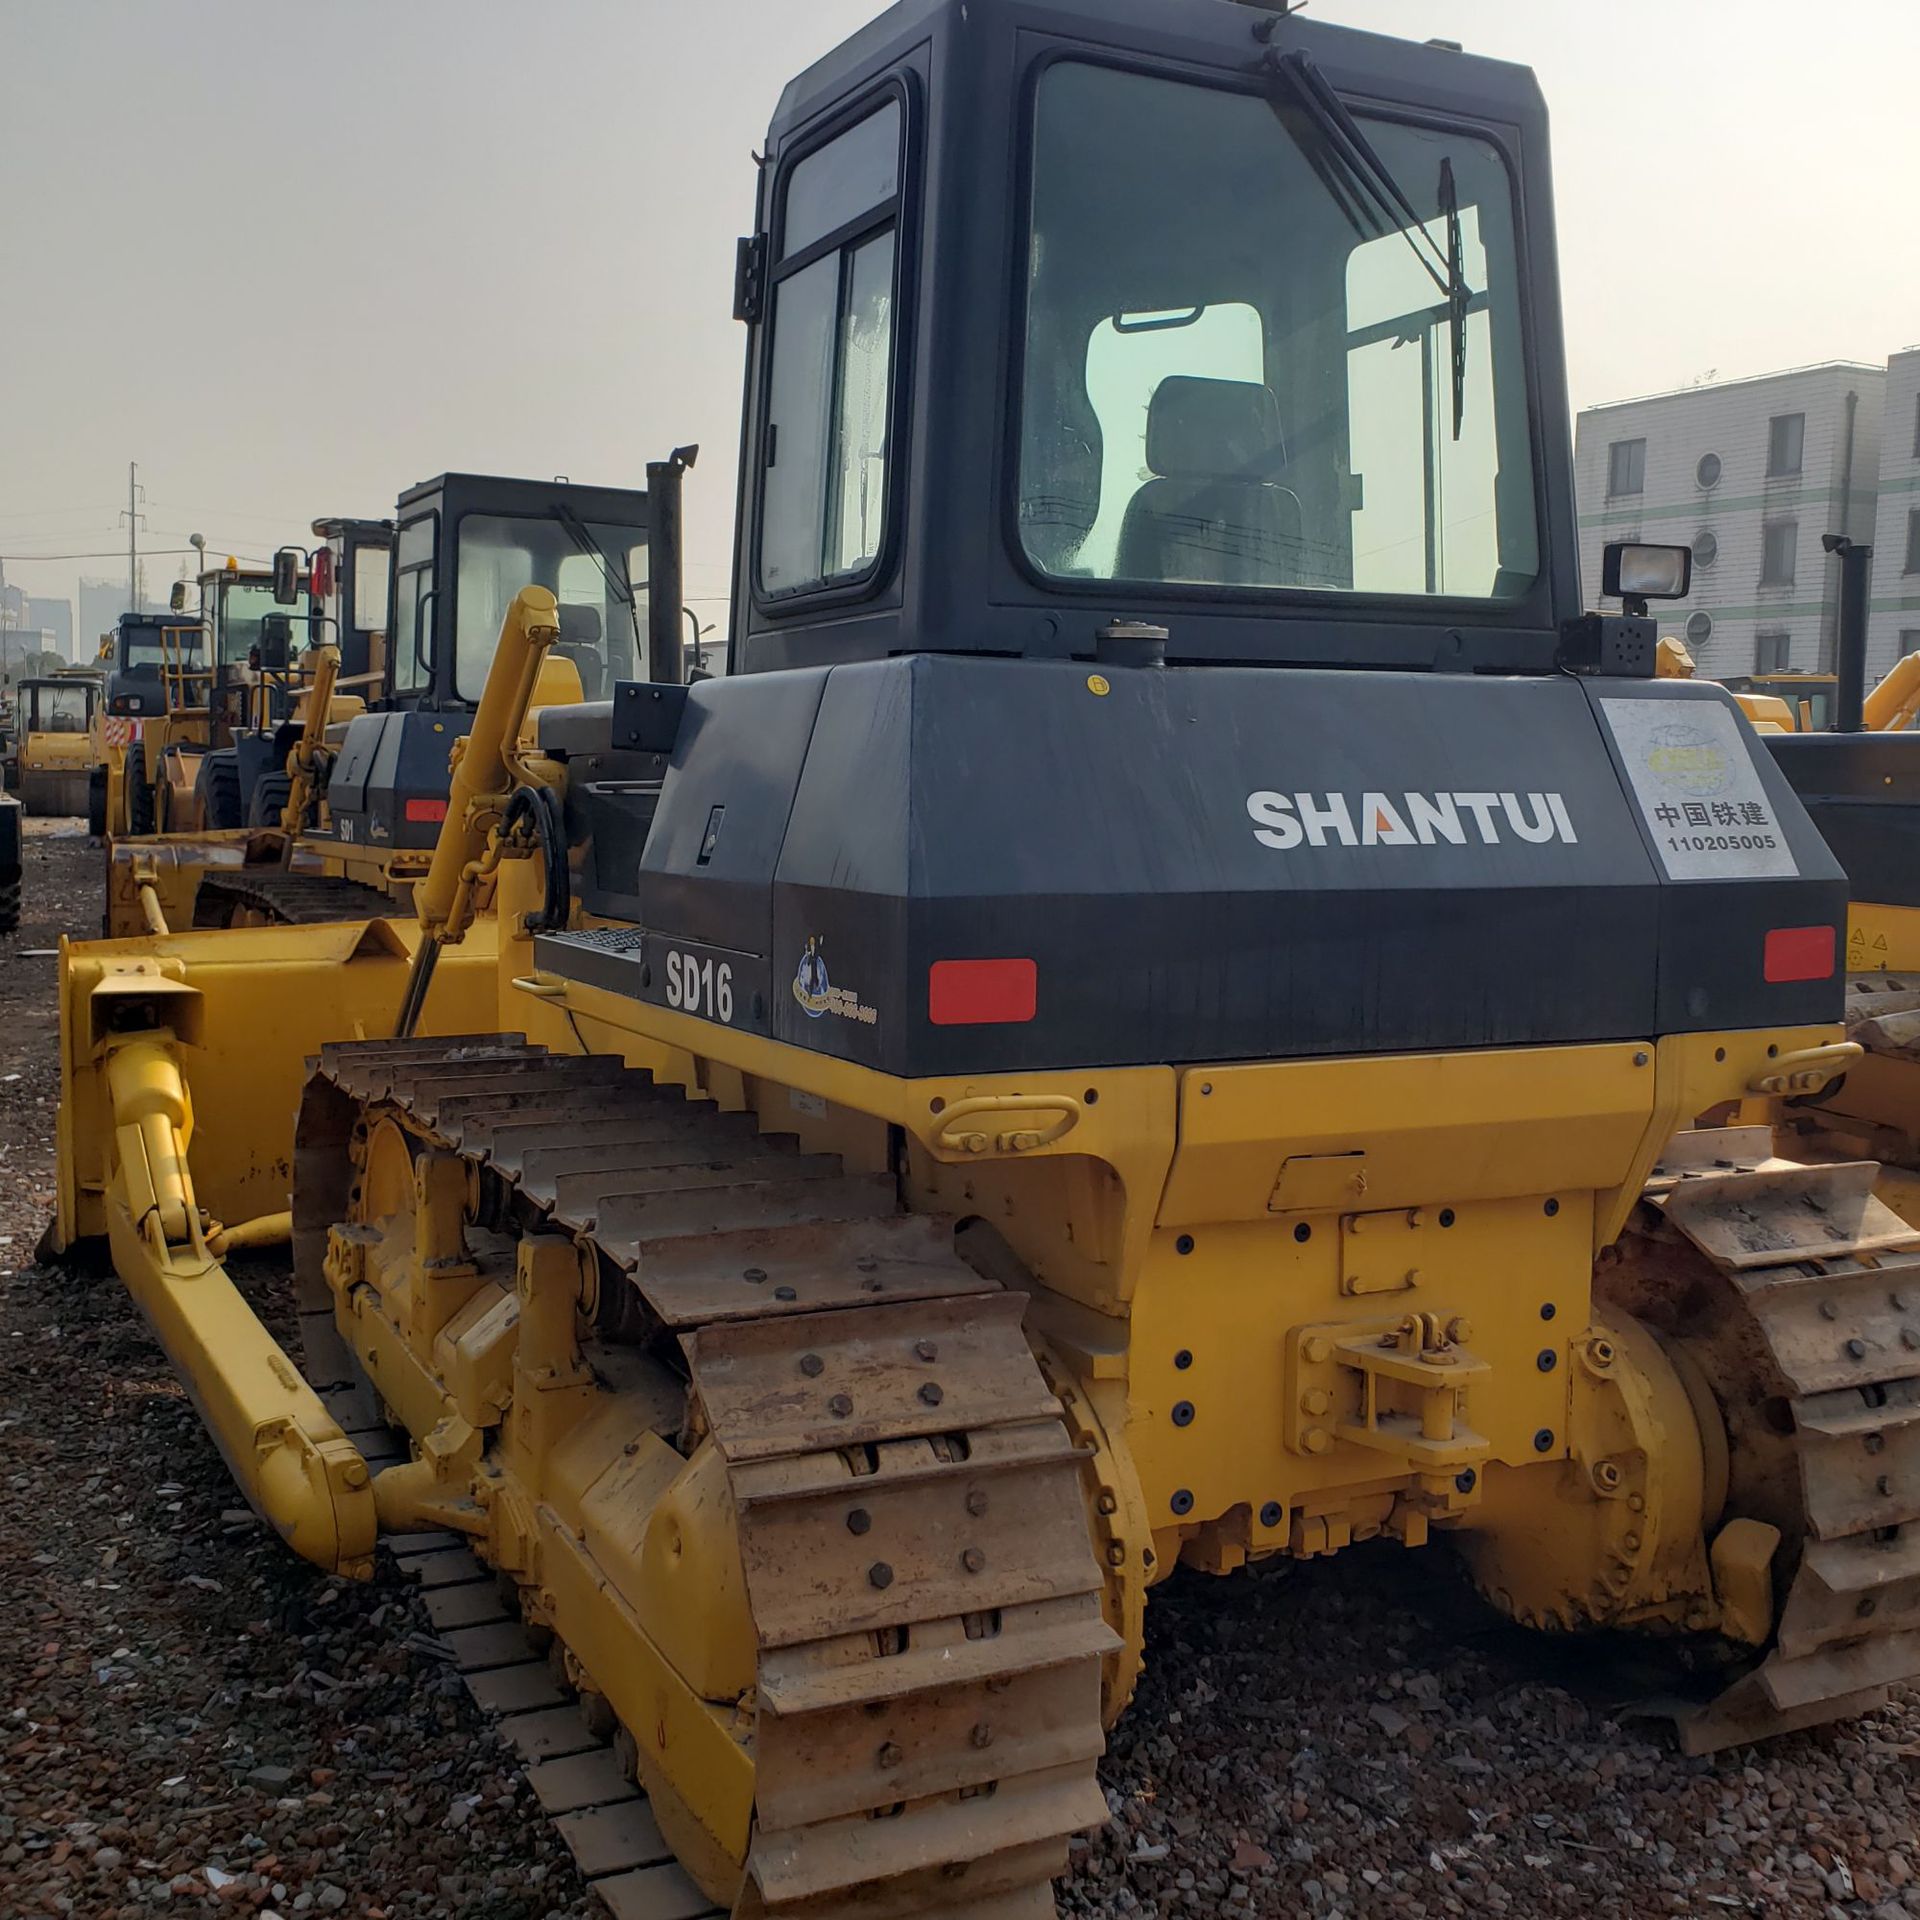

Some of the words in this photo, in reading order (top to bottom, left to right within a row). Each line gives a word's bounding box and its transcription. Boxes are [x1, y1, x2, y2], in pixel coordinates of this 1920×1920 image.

[1246, 790, 1579, 850] SHANTUI
[1654, 801, 1769, 828] 中国铁建
[1667, 834, 1777, 852] 110205005
[666, 950, 734, 1023] SD16
